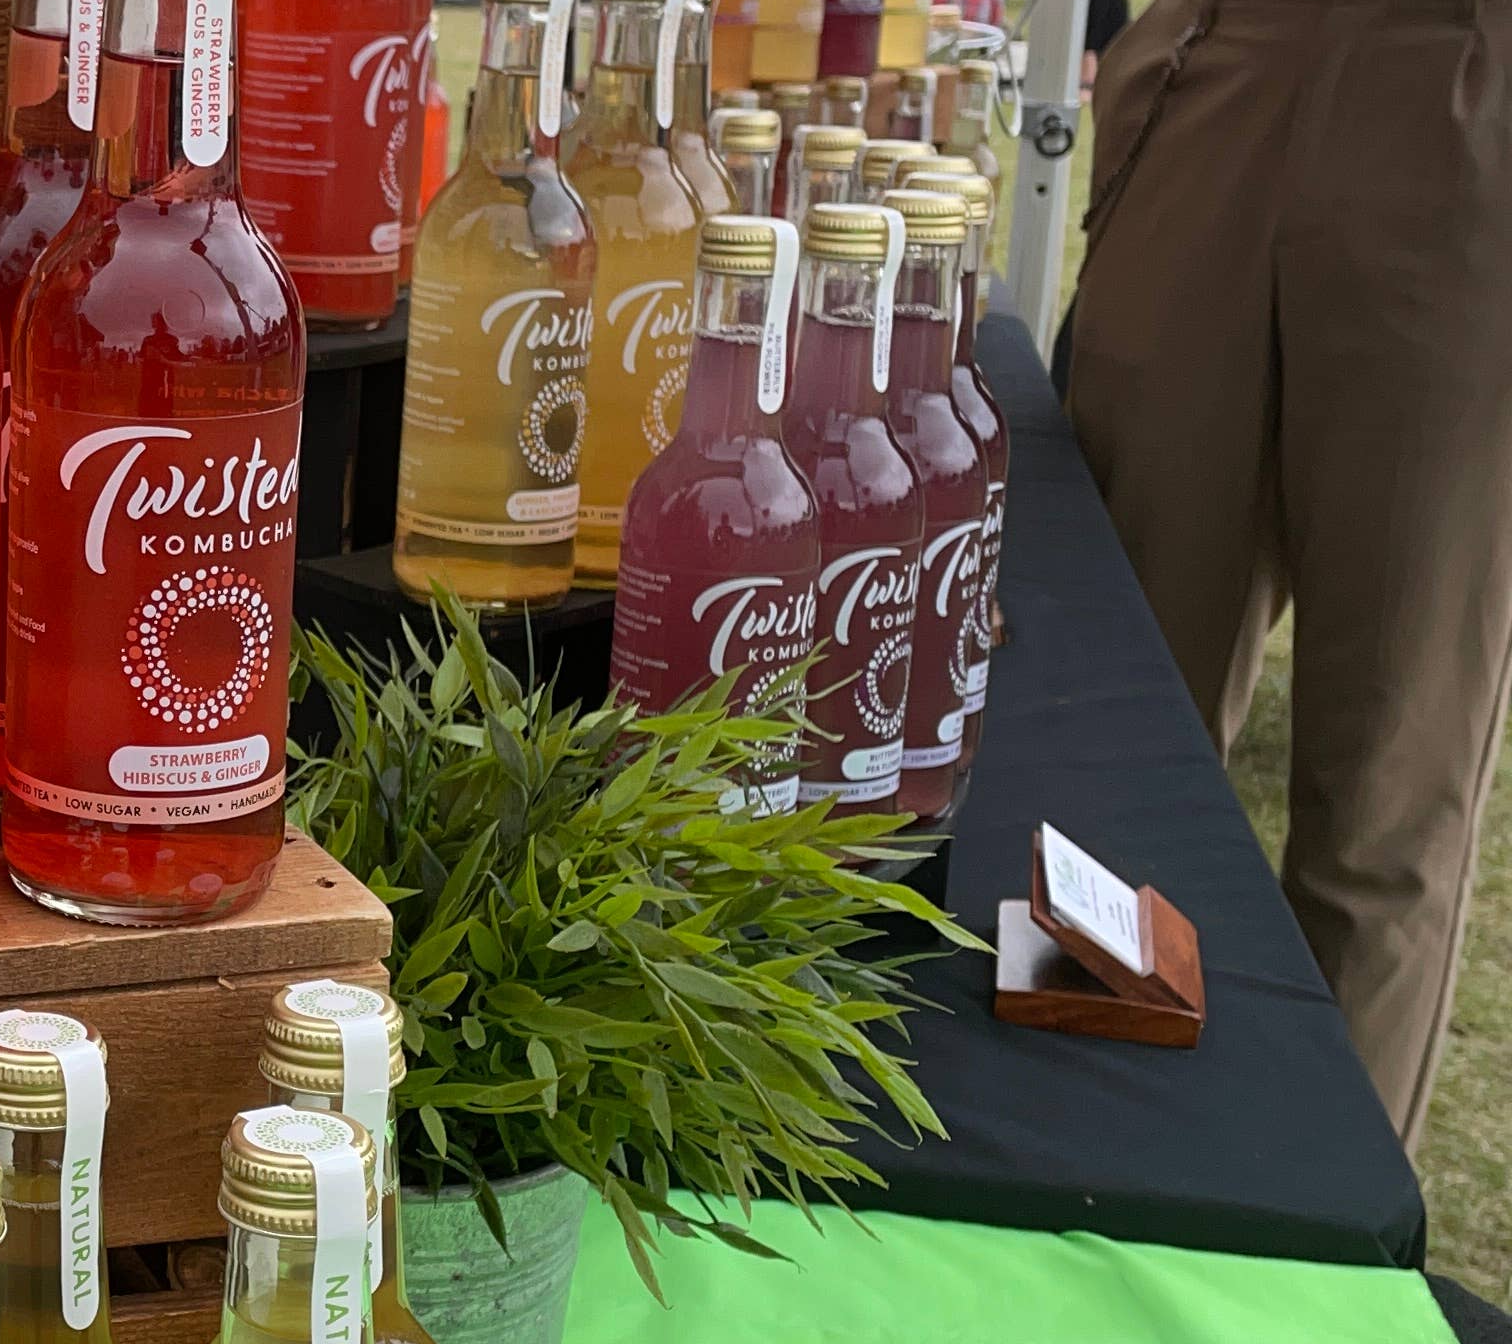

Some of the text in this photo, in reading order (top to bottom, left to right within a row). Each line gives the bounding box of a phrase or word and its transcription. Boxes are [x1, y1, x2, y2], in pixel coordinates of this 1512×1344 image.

[193, 46, 204, 59] &
[206, 17, 223, 138] STRAWBERRY
[189, 63, 204, 138] GINGER
[60, 409, 303, 575] Twisted
[141, 518, 294, 556] KOMBUCHA
[122, 761, 262, 787] HIBISCUS & GINGER
[149, 746, 248, 768] STRAWBERRY
[65, 798, 92, 813] LOW
[96, 802, 142, 818] SUGAR
[166, 803, 211, 817] VEGAN
[230, 786, 278, 811] HANDMADE
[70, 1158, 95, 1308] NATURAL
